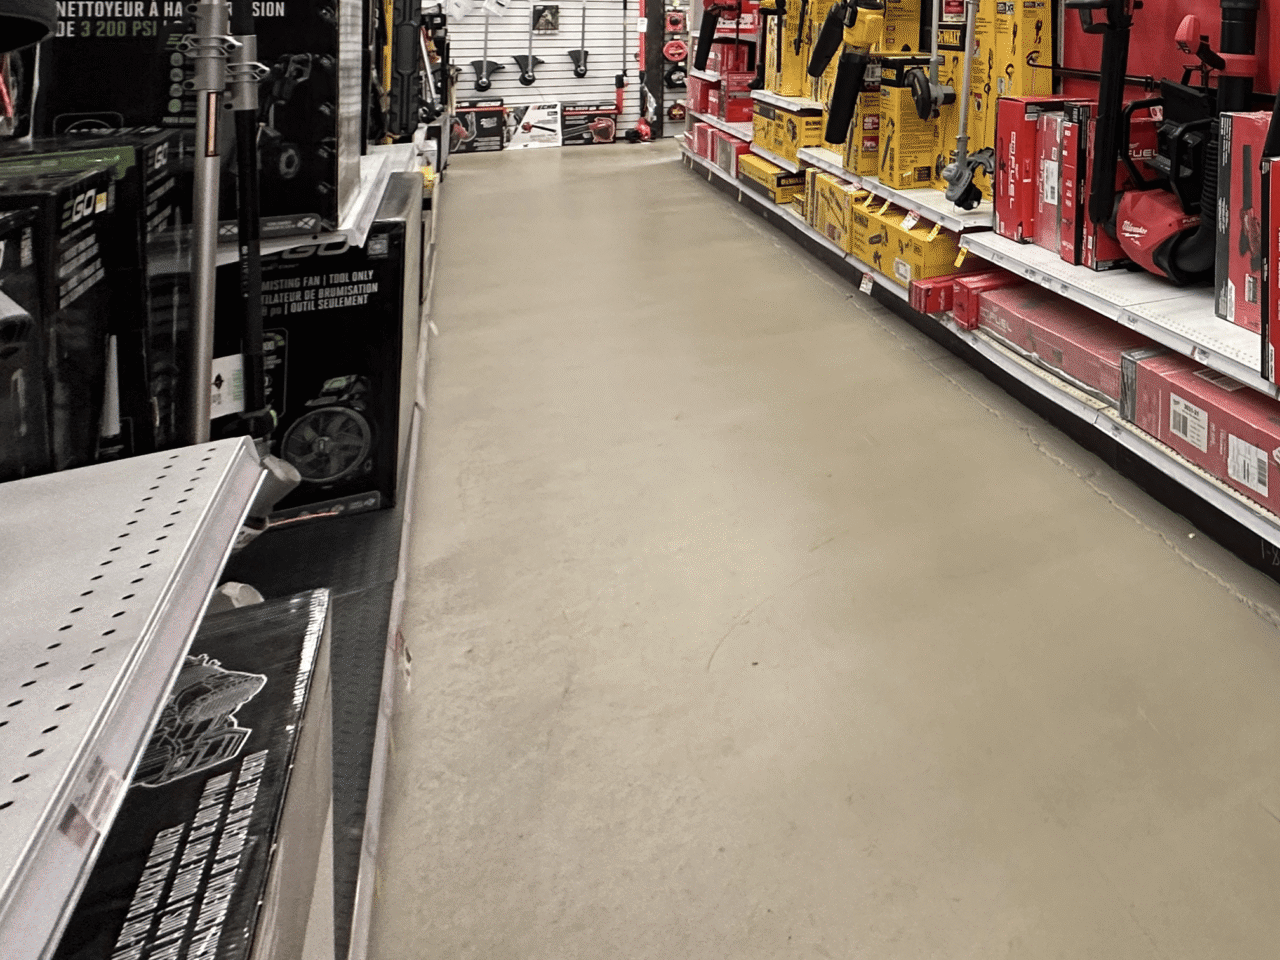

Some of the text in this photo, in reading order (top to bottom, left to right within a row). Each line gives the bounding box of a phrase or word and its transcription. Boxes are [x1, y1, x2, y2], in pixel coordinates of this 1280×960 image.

[55, 1, 145, 18] NETTOYEUR
[81, 21, 91, 37] 3
[96, 21, 126, 37] 200
[132, 21, 157, 37] PSI
[303, 275, 321, 287] FAN
[329, 272, 349, 284] TOOL
[352, 269, 374, 282] ONLY
[318, 282, 379, 299] BRUMISATION
[290, 294, 369, 313] OUTIL SEULEMENT
[125, 822, 186, 919] BACKPACK BLOWER
[167, 859, 208, 905] DOUBLE
